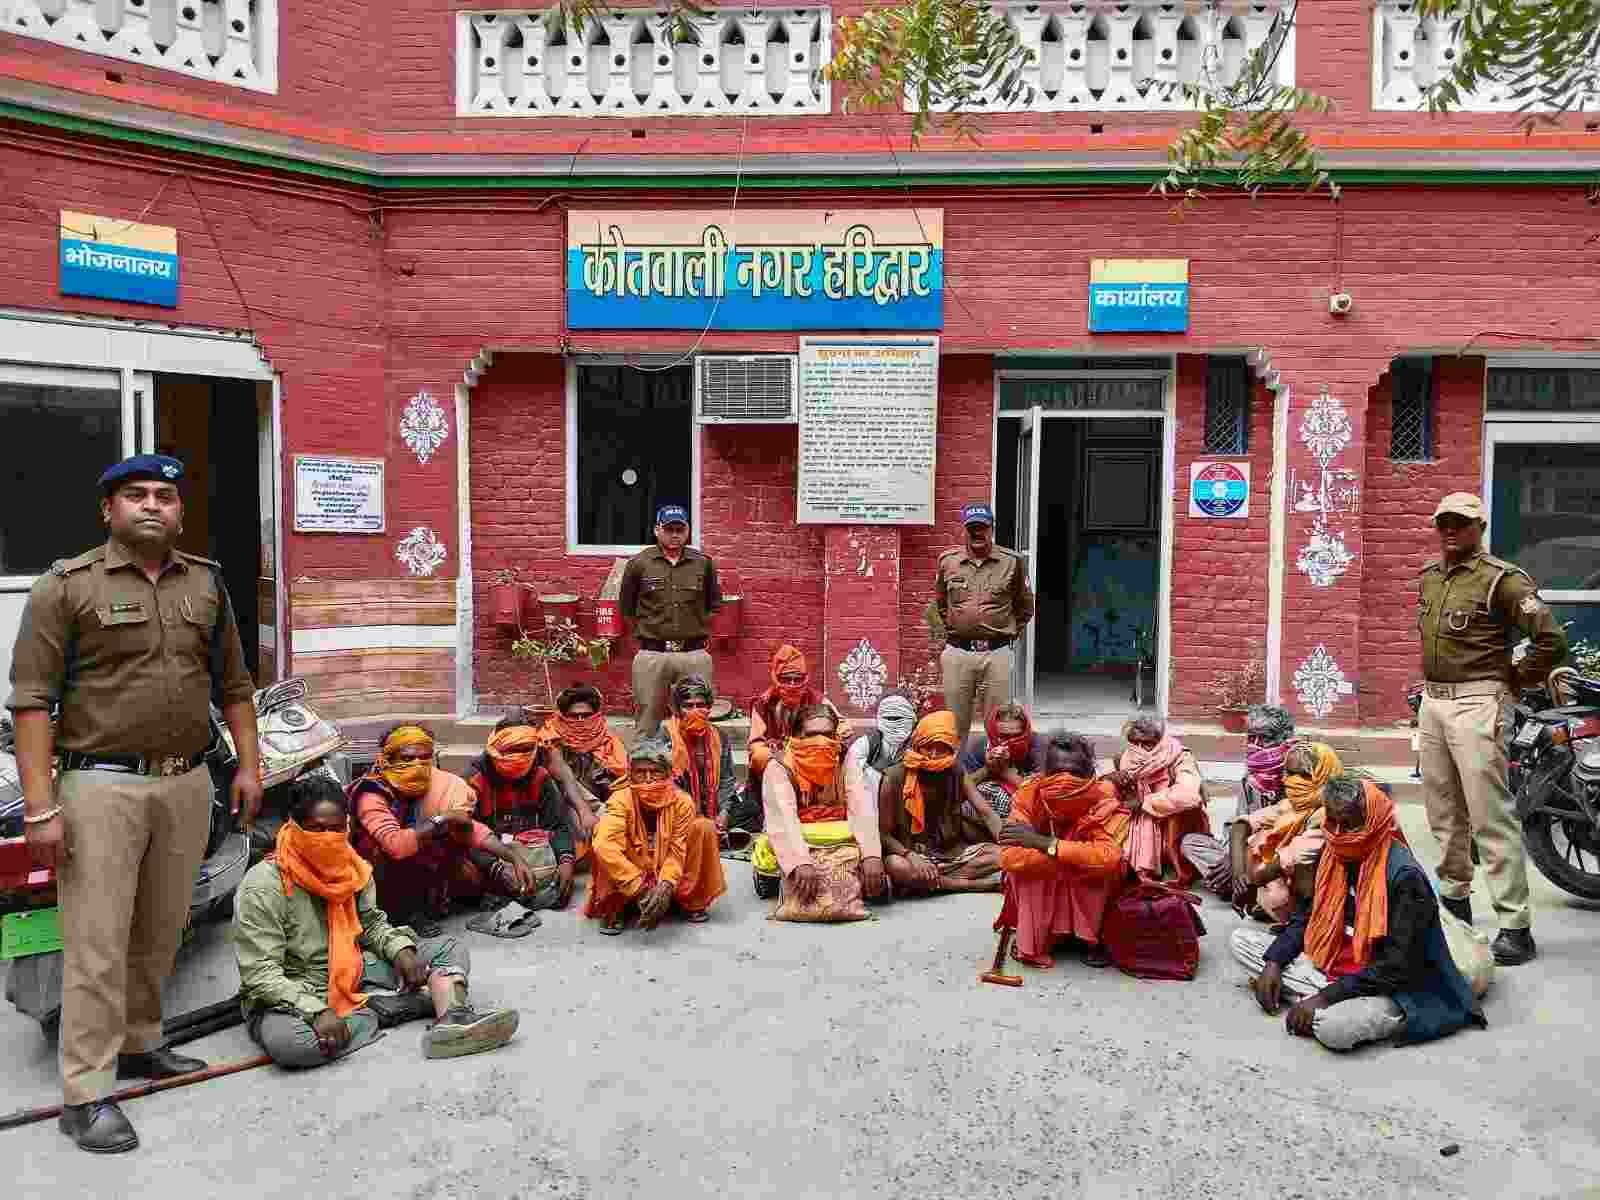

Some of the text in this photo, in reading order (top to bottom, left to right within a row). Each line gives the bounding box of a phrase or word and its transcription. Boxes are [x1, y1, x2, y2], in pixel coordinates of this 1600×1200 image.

[65, 243, 172, 278] भोजनालय
[582, 224, 931, 305] कोतवाली नगर हरिद्वार
[1095, 284, 1185, 307] कार्यालय
